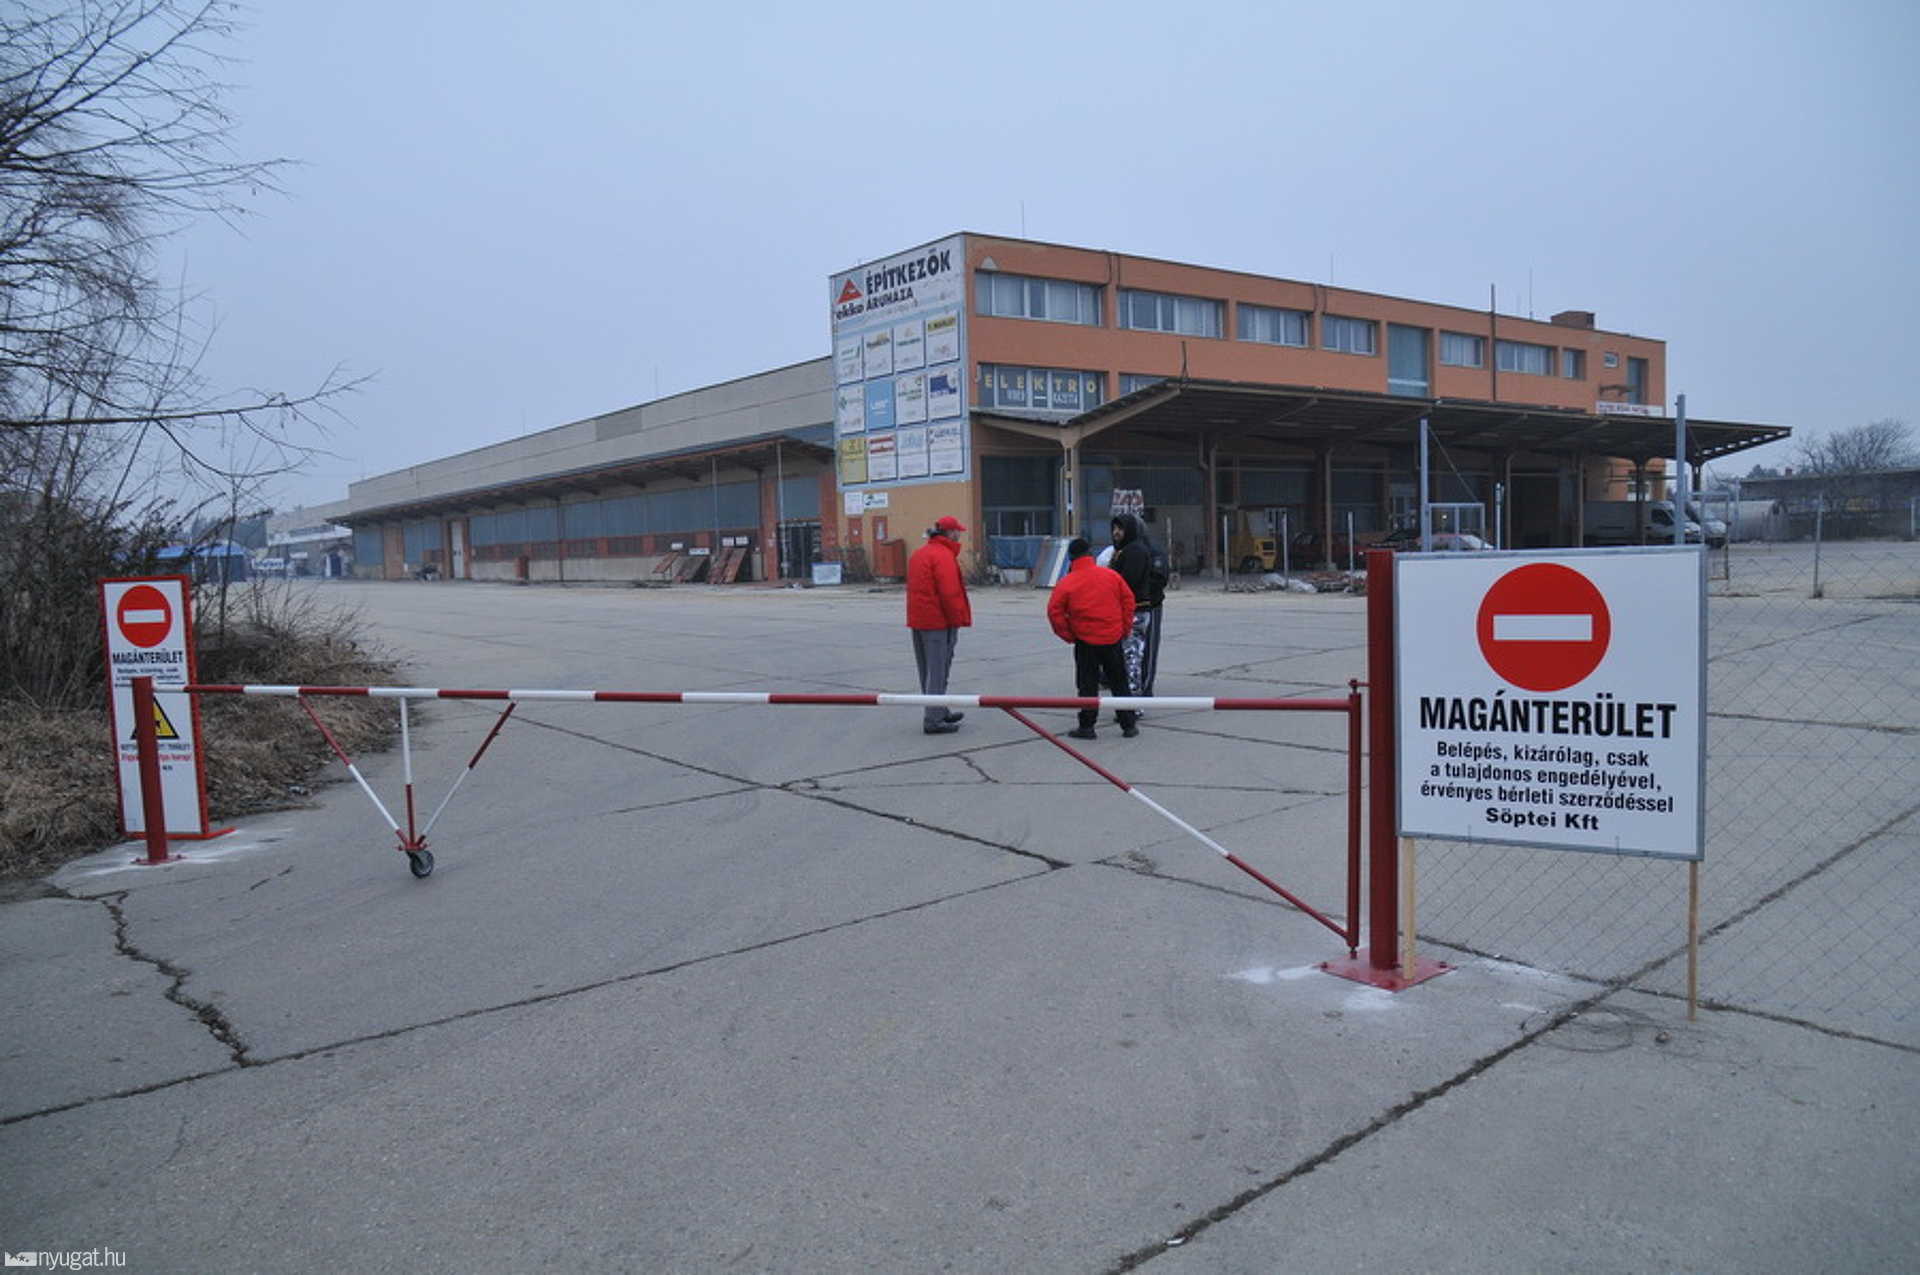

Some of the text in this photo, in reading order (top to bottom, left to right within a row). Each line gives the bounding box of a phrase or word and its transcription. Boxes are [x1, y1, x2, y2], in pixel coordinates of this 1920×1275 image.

[1420, 690, 1676, 738] MAGÁNTERÜLET
[1437, 741, 1650, 767] Belépés, kizárólag, csak
[1430, 762, 1662, 792] a tulajdonos engedélyével,
[1420, 780, 1493, 801] érvényes
[1499, 786, 1554, 805] bérleti
[1486, 807, 1600, 830] Söptei Kft
